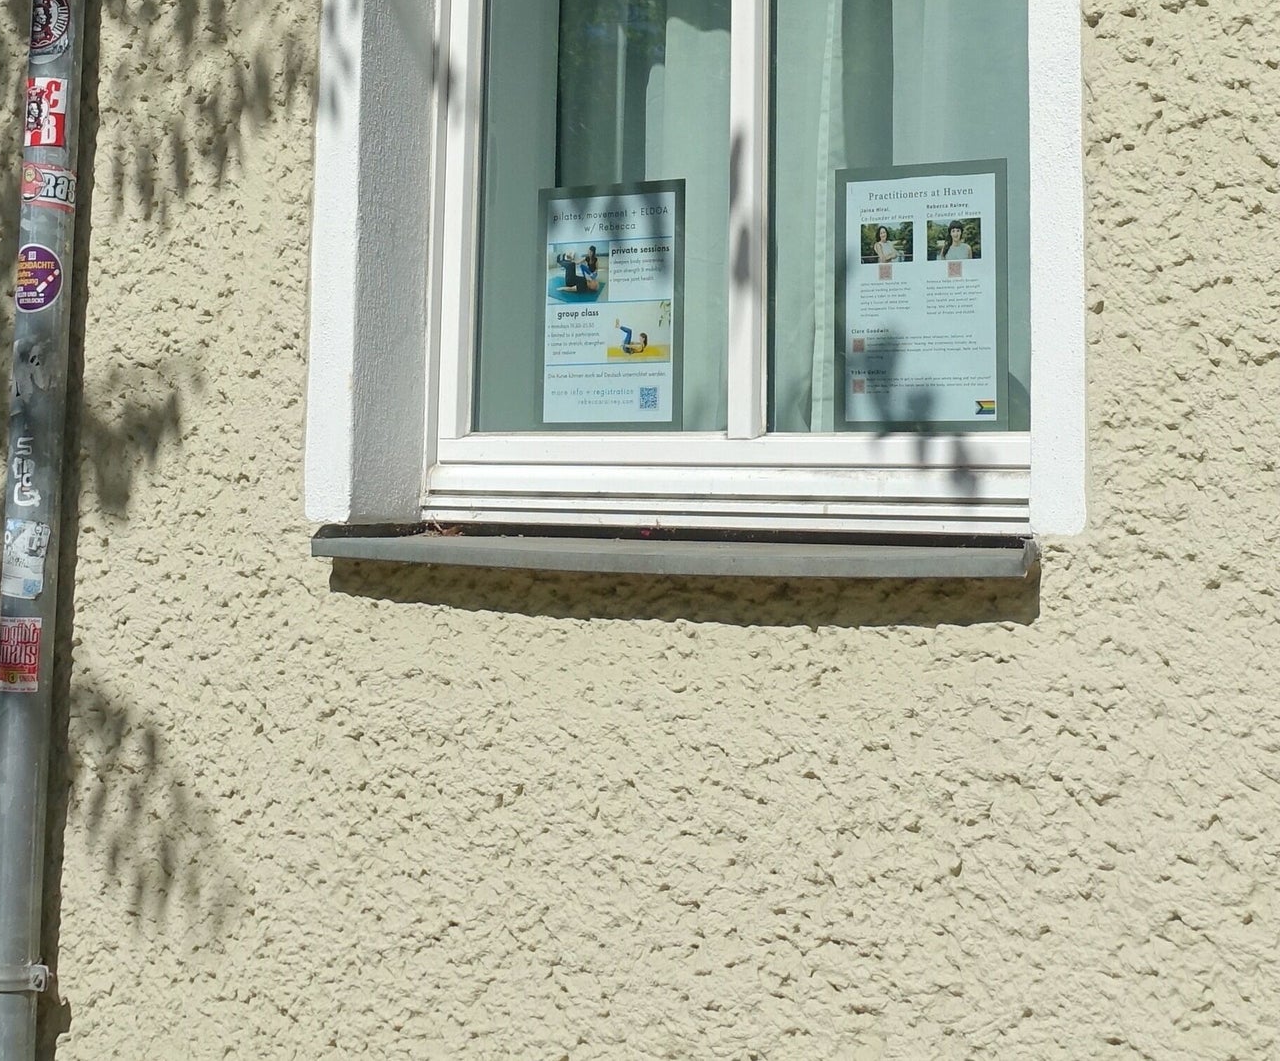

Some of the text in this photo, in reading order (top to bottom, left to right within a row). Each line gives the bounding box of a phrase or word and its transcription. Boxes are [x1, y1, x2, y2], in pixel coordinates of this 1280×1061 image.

[869, 186, 974, 201] Practitioners at Haven
[553, 211, 584, 224] pilates,
[586, 209, 627, 220] movement
[640, 206, 668, 216] ELDOA
[584, 222, 636, 234] w/ Rebecca
[611, 244, 670, 257] private sessions
[557, 307, 599, 320] group class
[593, 387, 634, 398] registration
